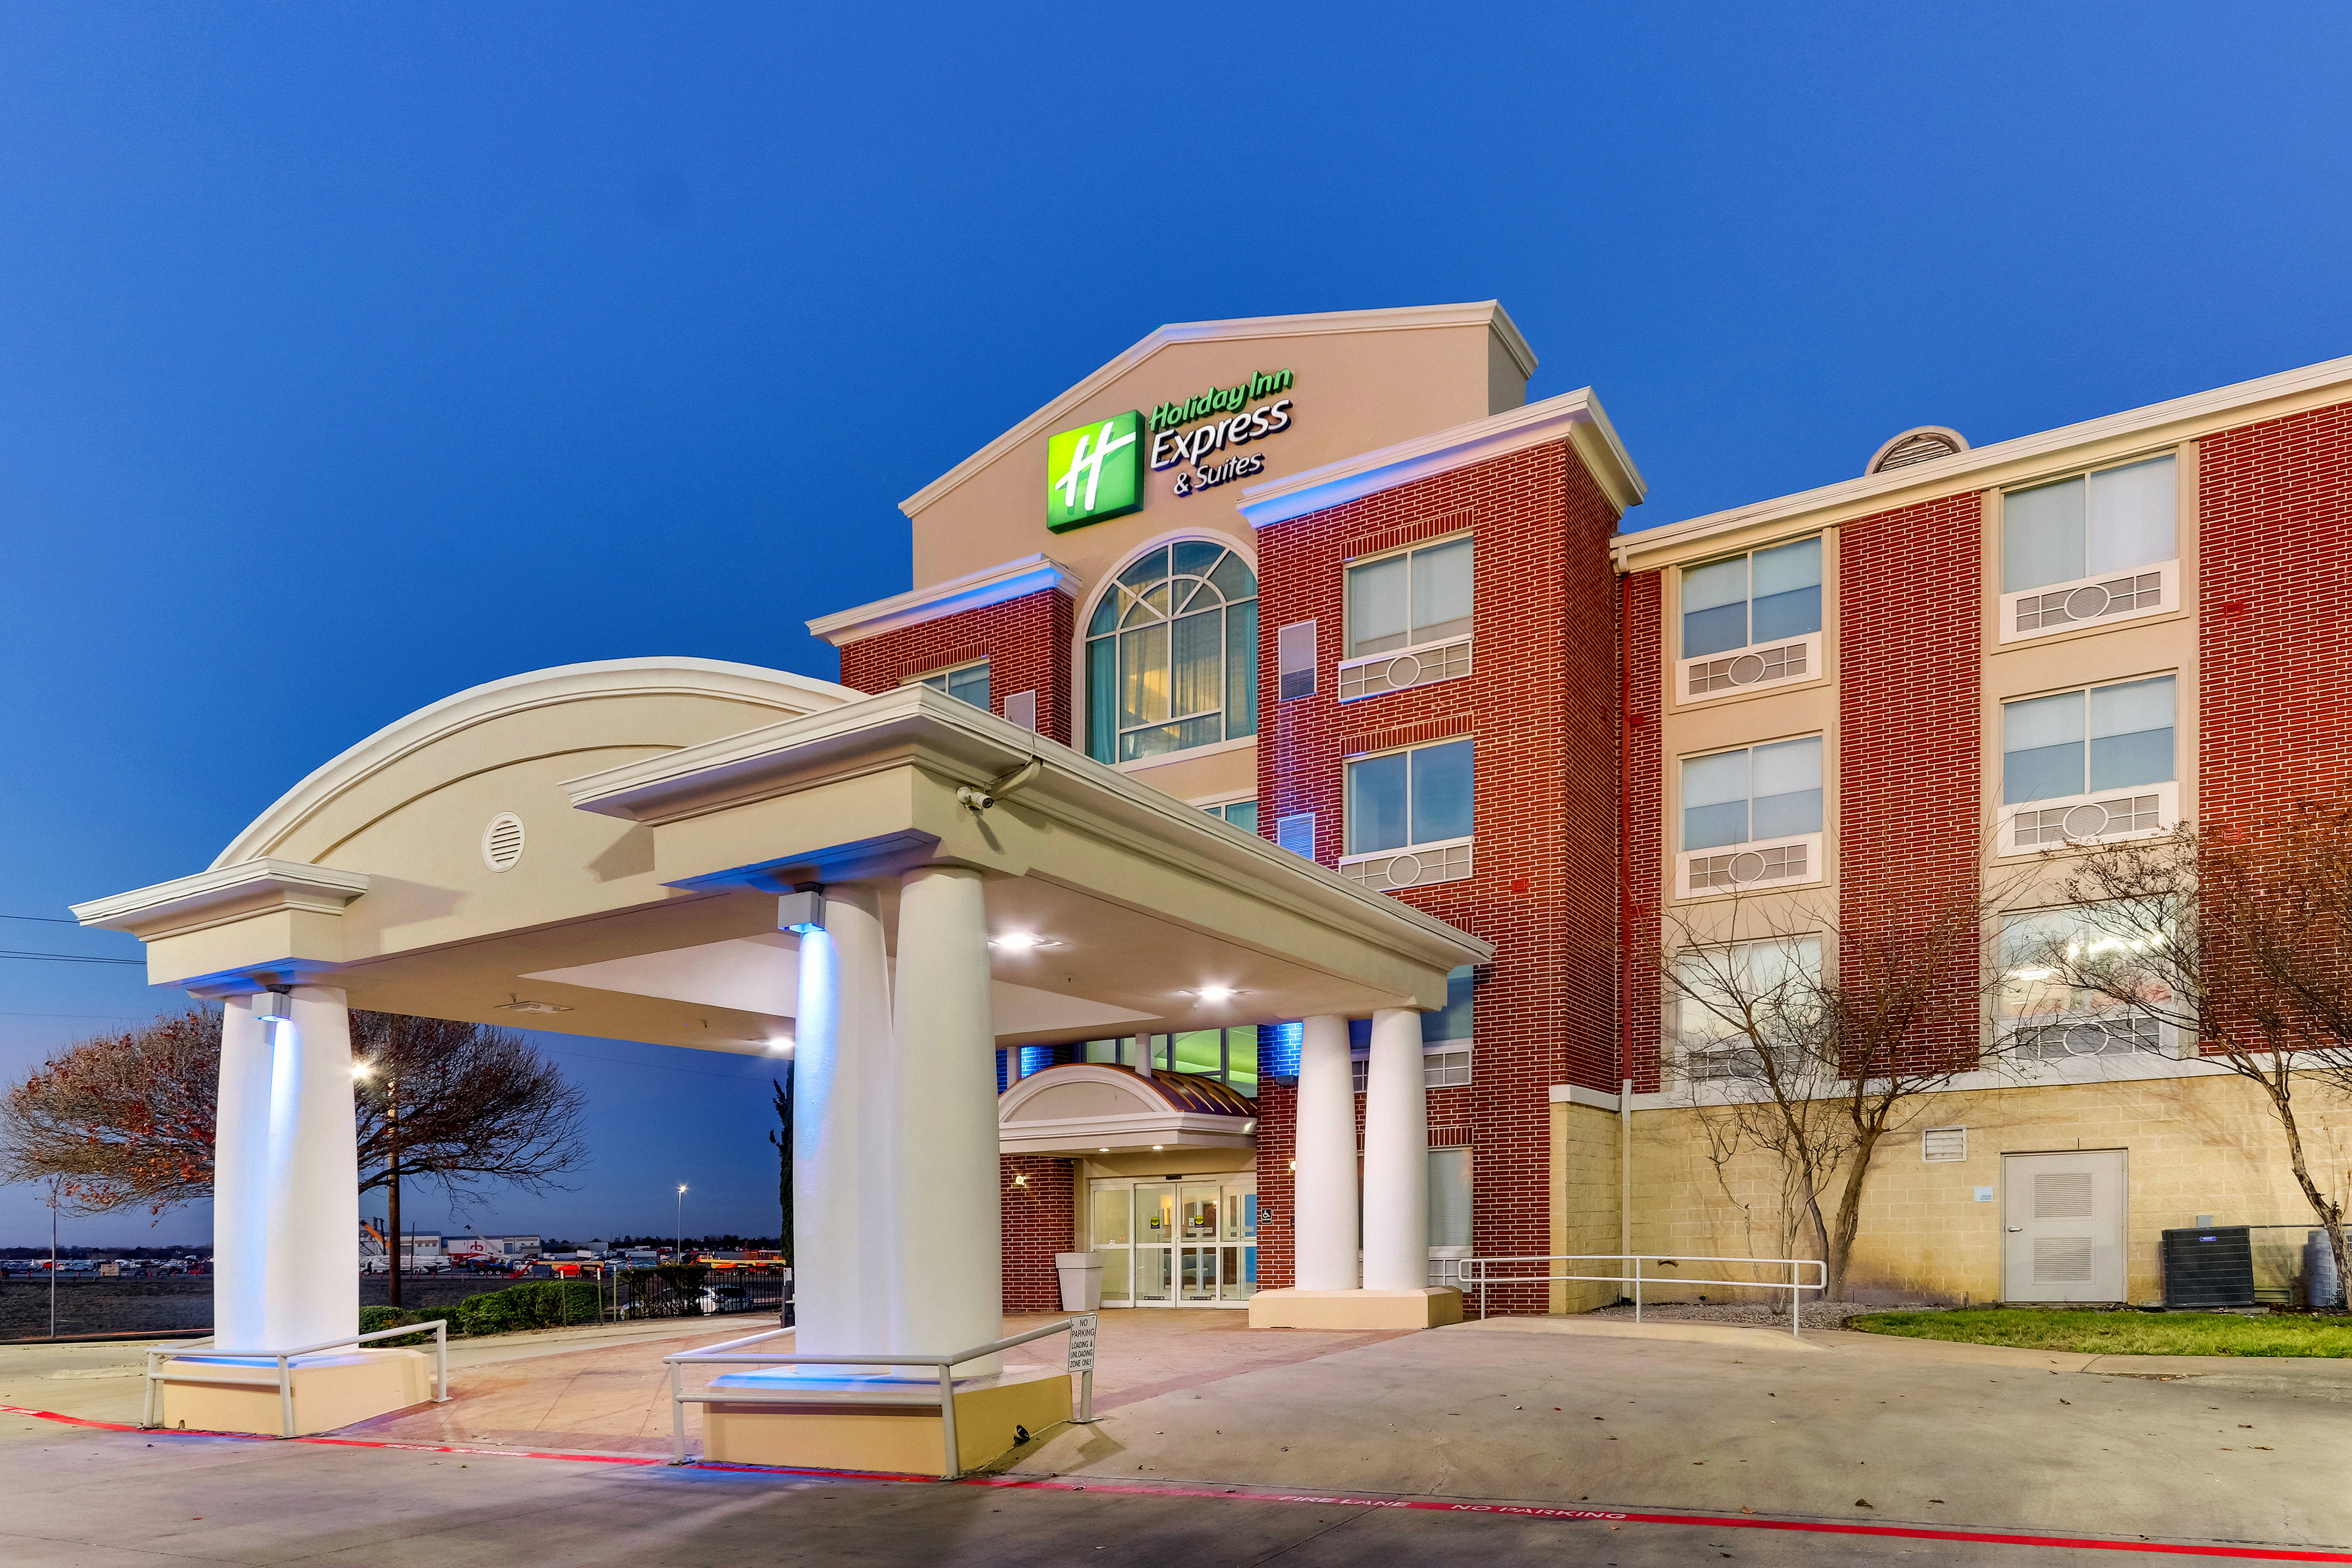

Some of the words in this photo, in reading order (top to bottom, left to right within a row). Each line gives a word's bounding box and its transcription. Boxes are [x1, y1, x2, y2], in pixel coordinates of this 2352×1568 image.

[1148, 384, 1248, 432] Holiday
[1250, 368, 1293, 399] Inn
[1150, 399, 1292, 470] Express
[1173, 472, 1193, 497] &
[1194, 453, 1265, 490] Suites
[1072, 1329, 1095, 1338] PARKING
[1071, 1340, 1088, 1349] LOADING
[1070, 1349, 1093, 1359] UNLOADING
[1499, 1507, 1627, 1520] PARKING
